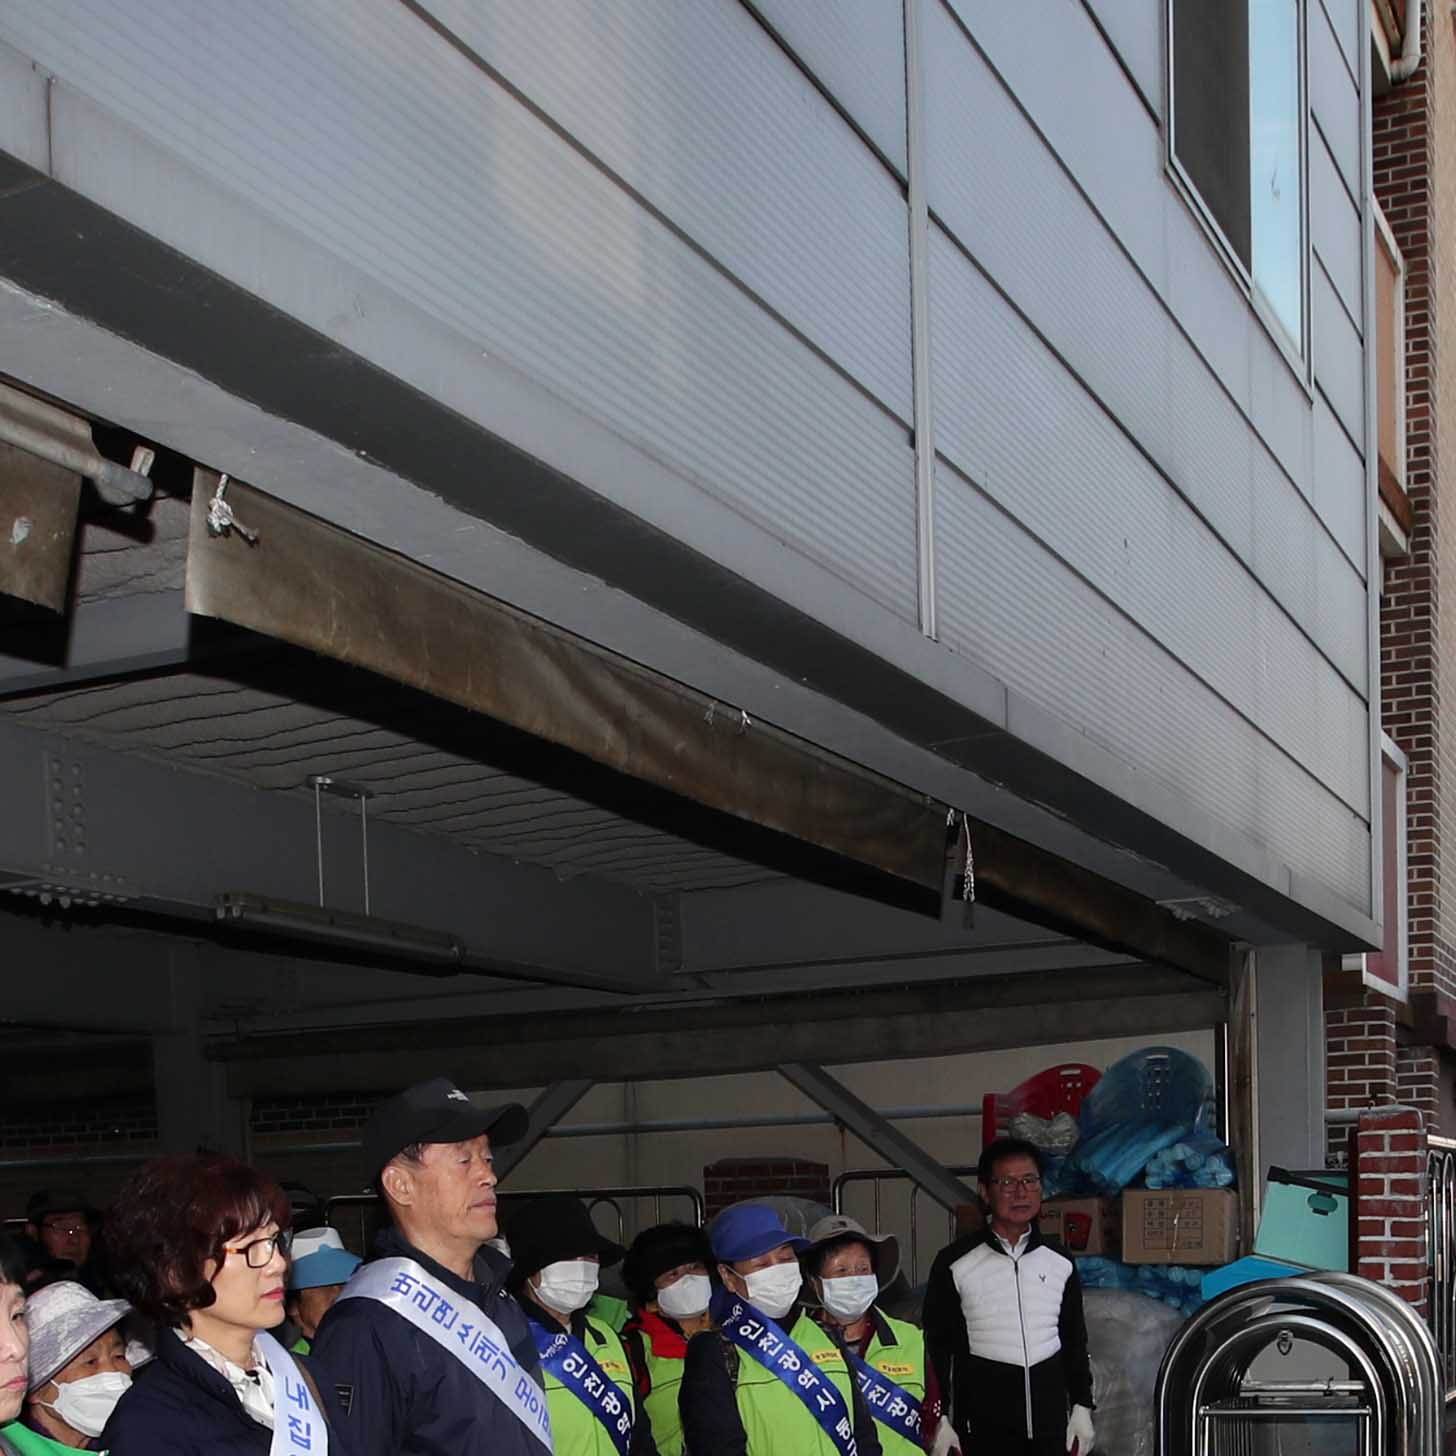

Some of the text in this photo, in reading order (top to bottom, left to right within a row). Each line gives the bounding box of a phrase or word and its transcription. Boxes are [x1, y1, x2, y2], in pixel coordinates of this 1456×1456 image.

[390, 1271, 460, 1330] 버리면
[284, 1375, 311, 1412] 내
[741, 1320, 837, 1413] 인천광역시
[560, 1352, 633, 1444] 인천광역
[287, 1415, 312, 1453] 집
